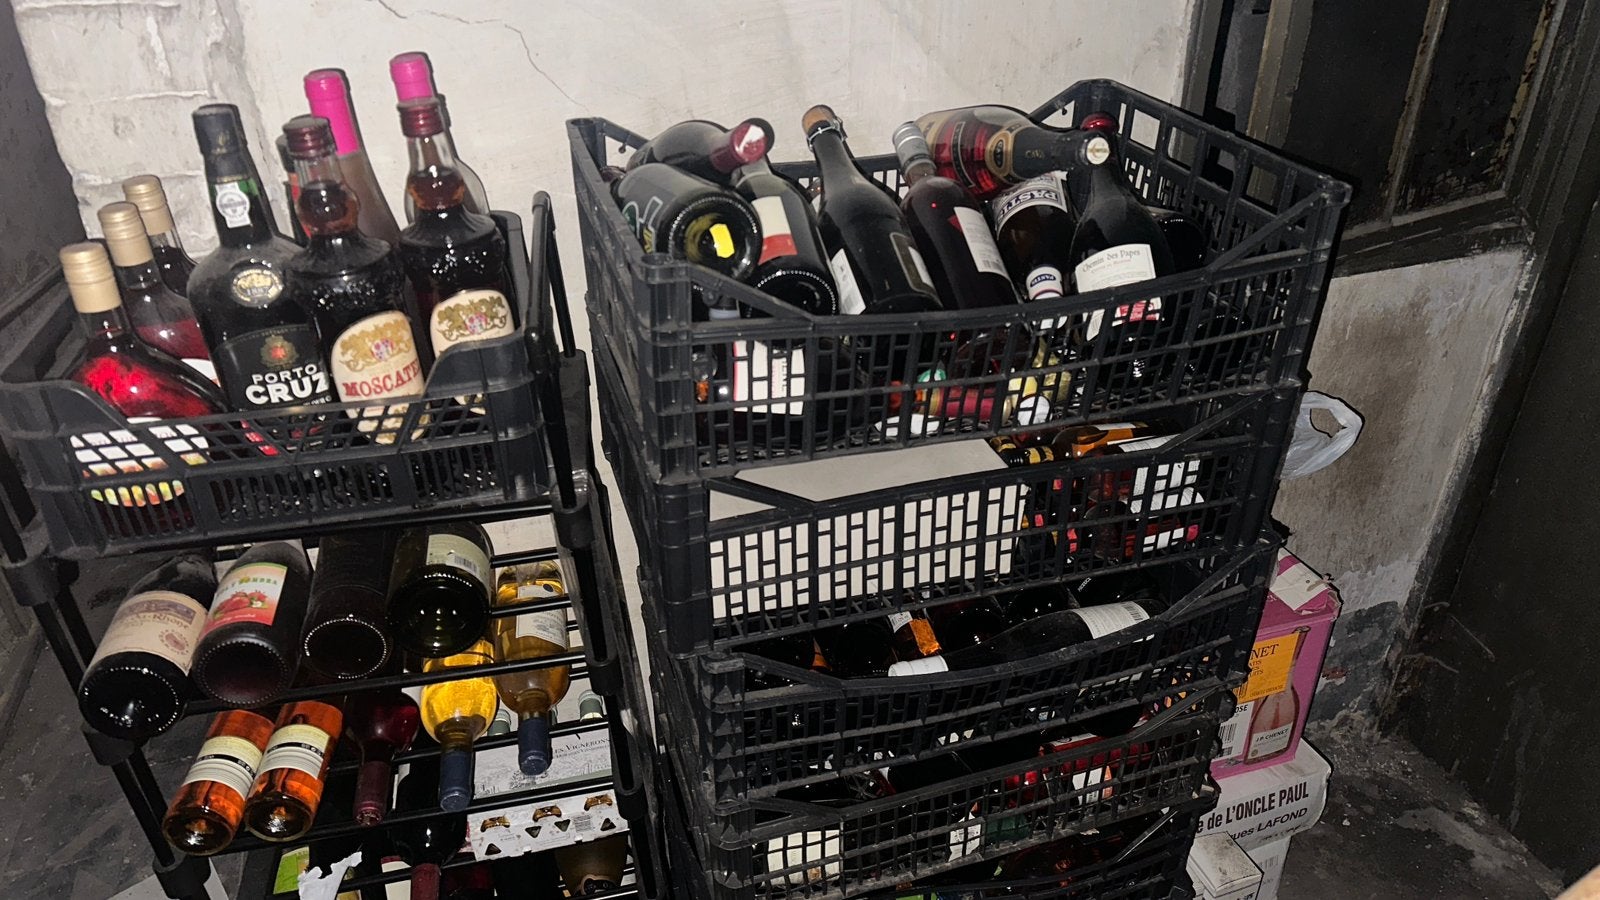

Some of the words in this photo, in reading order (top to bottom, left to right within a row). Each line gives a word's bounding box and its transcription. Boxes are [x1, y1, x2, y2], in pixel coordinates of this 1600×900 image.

[245, 371, 329, 405] CRUZ
[252, 363, 317, 385] PORTO
[1207, 813, 1223, 830] de
[1279, 782, 1309, 807] PAUL
[1257, 807, 1308, 832] LAFOND
